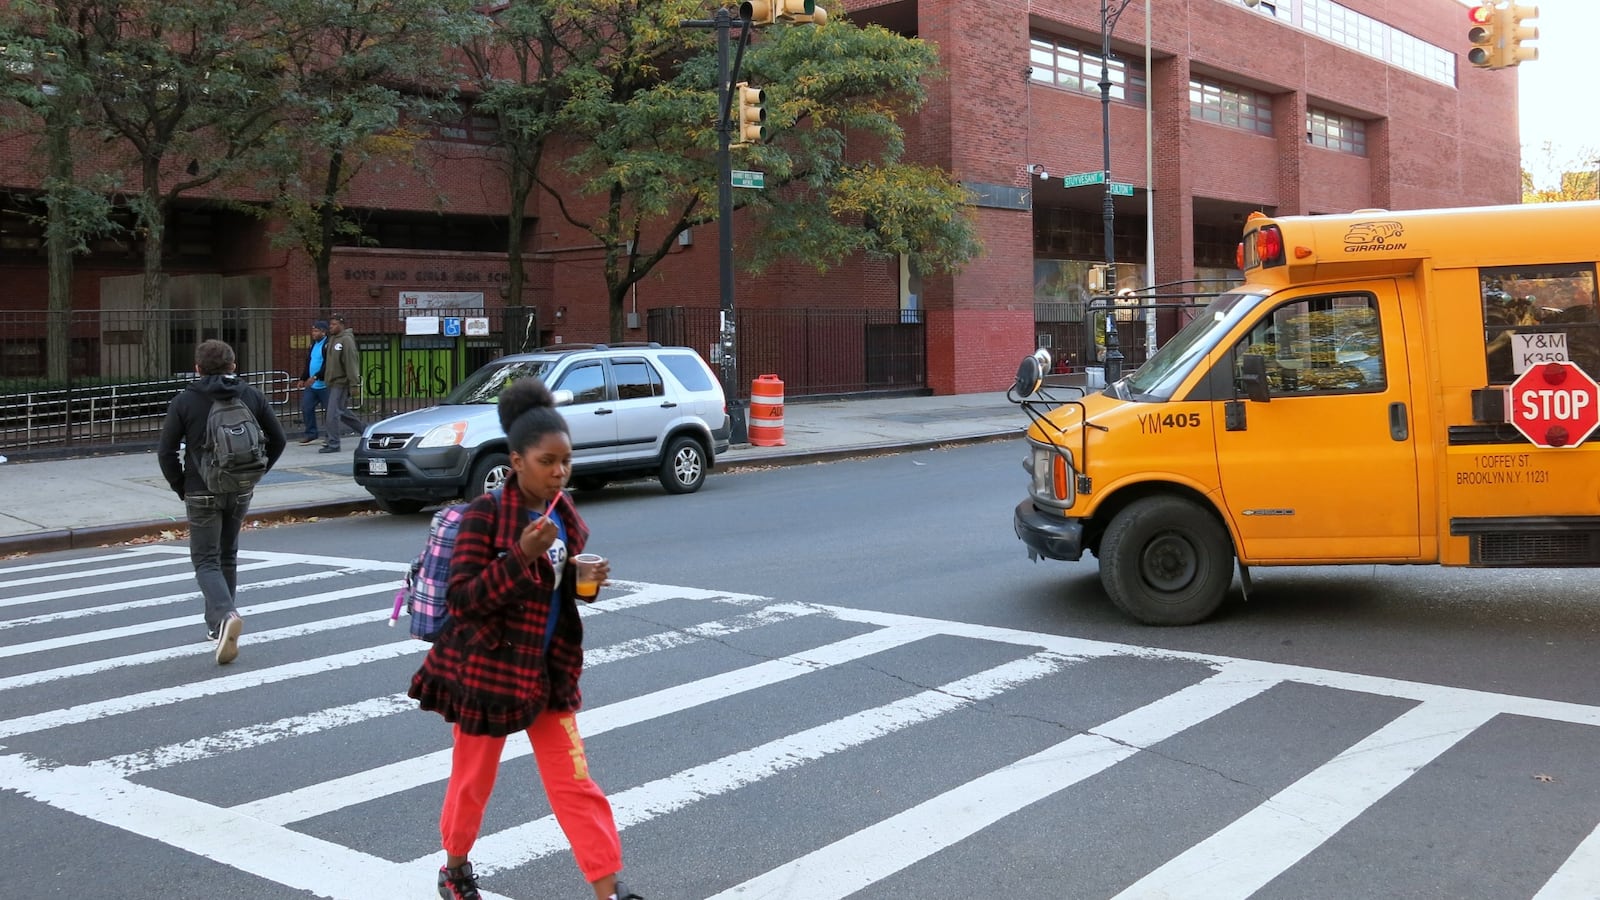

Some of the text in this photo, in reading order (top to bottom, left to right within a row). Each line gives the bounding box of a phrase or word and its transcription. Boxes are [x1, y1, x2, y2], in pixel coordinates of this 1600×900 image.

[1065, 173, 1098, 186] STUYVESANT
[1343, 243, 1407, 253] GIRARDIN
[344, 269, 376, 280] BOYS
[384, 270, 407, 280] AND
[415, 271, 447, 281] GIRLS
[488, 272, 530, 282] SCHL
[1521, 334, 1565, 349] Y&M
[1521, 389, 1589, 420] STOP
[1137, 412, 1201, 434] YM405
[1474, 455, 1479, 468] 1
[1481, 454, 1516, 468] COFFEY
[1456, 471, 1505, 485] BROOKLYN
[1526, 470, 1549, 483] 11231
